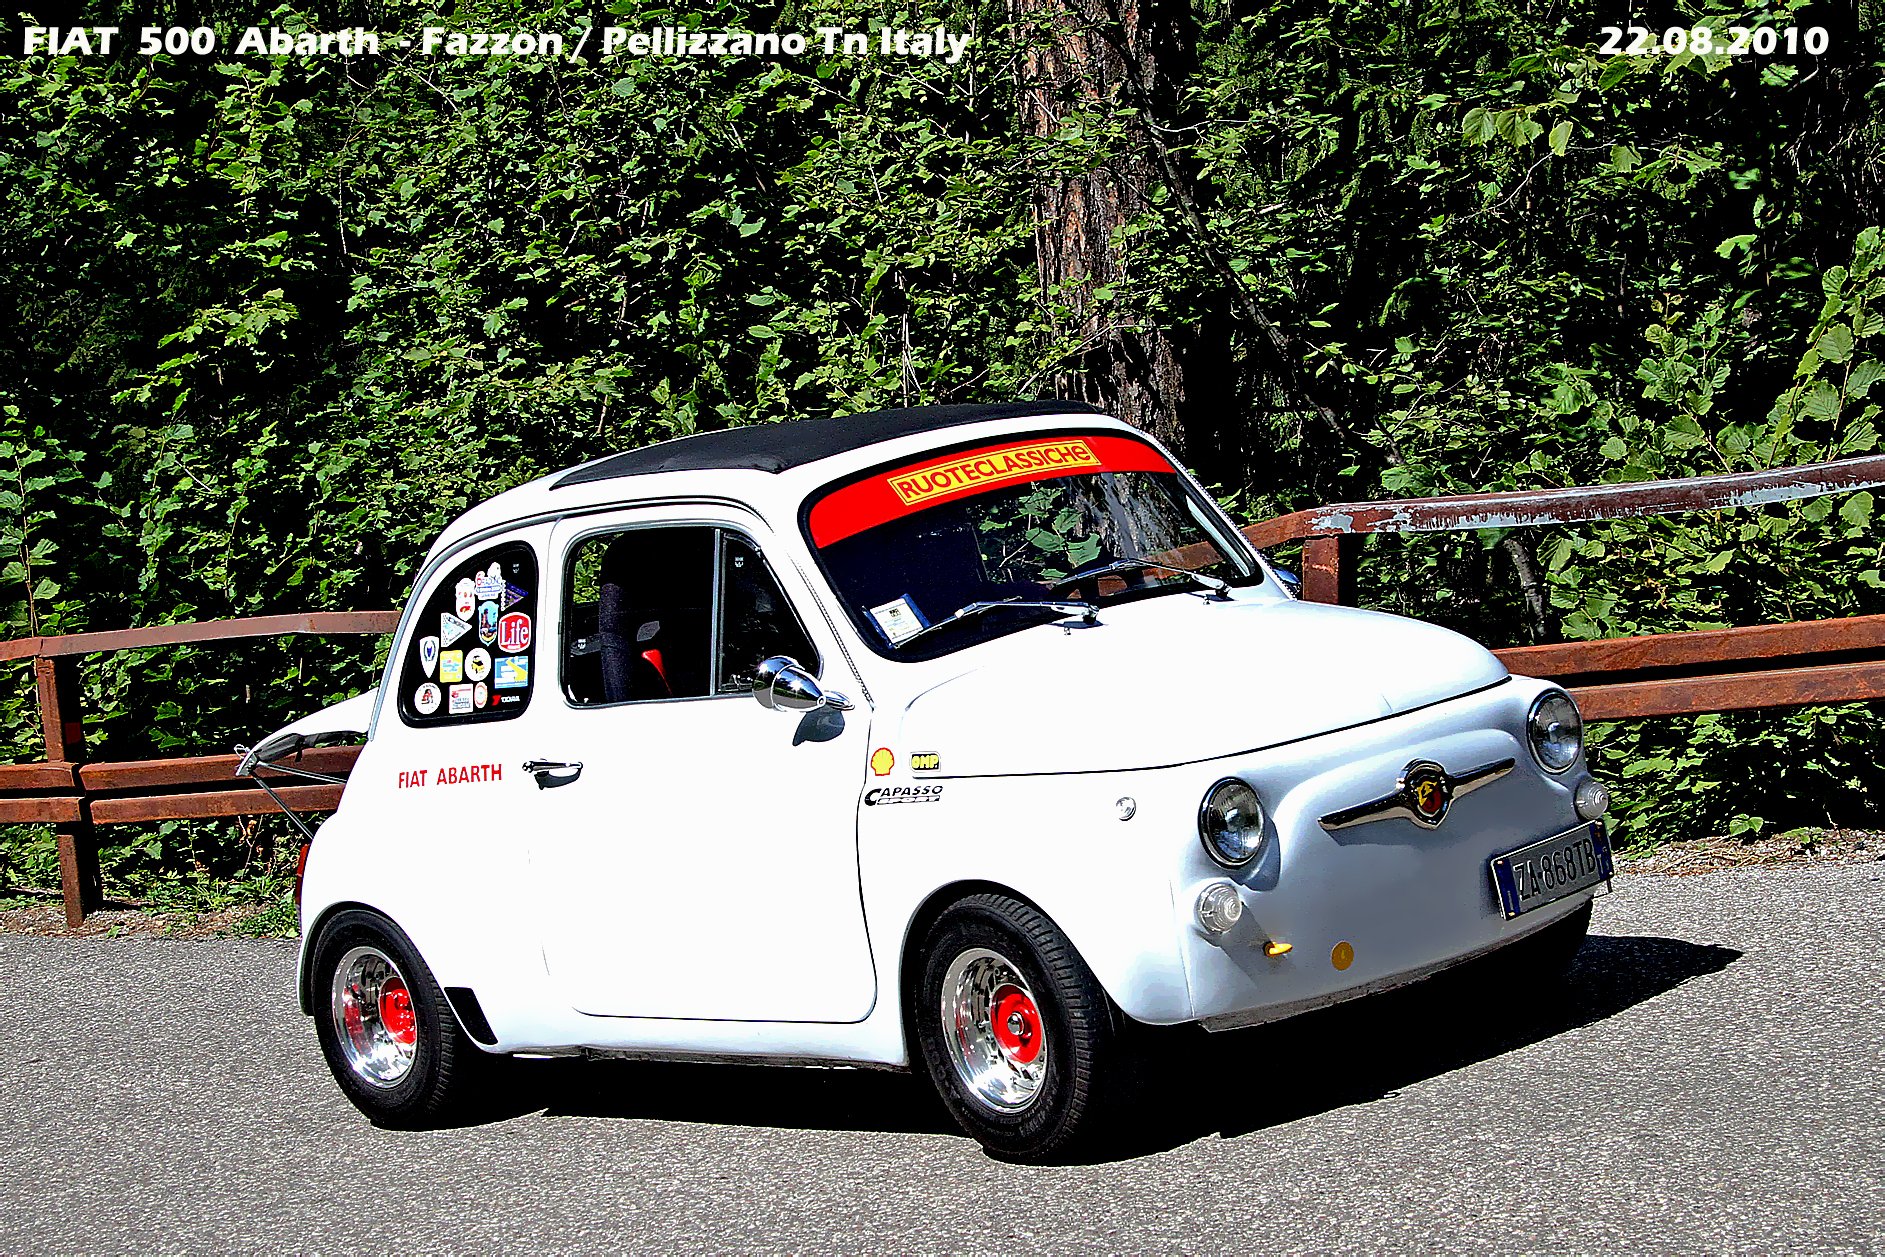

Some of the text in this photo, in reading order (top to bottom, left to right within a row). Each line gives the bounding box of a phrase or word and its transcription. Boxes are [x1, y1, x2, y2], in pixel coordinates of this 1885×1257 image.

[501, 619, 529, 646] Life
[398, 763, 502, 788] FIAT ABARTH
[864, 785, 944, 806] CAPASSO
